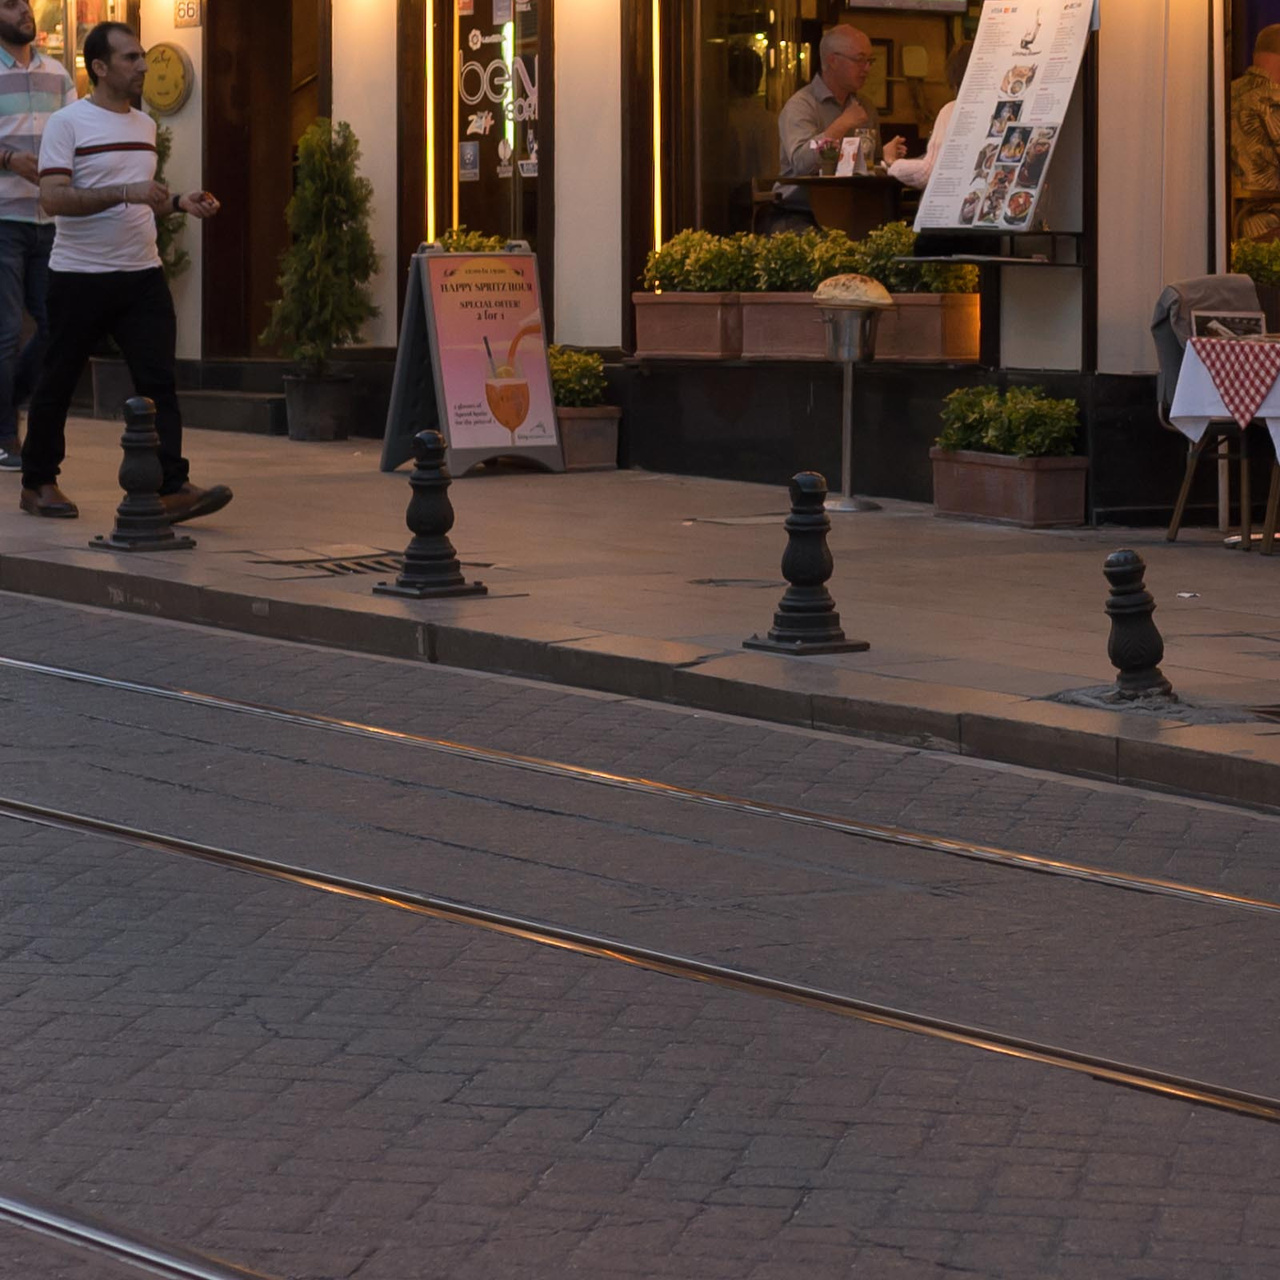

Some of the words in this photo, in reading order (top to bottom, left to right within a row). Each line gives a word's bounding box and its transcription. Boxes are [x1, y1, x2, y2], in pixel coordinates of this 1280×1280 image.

[178, 2, 196, 19] 66
[441, 283, 472, 293] HAPPY
[475, 282, 507, 292] SPRITZ
[508, 282, 533, 292] HOUR
[460, 300, 493, 310] SPECIAL
[477, 313, 483, 321] 2
[484, 309, 498, 321] for
